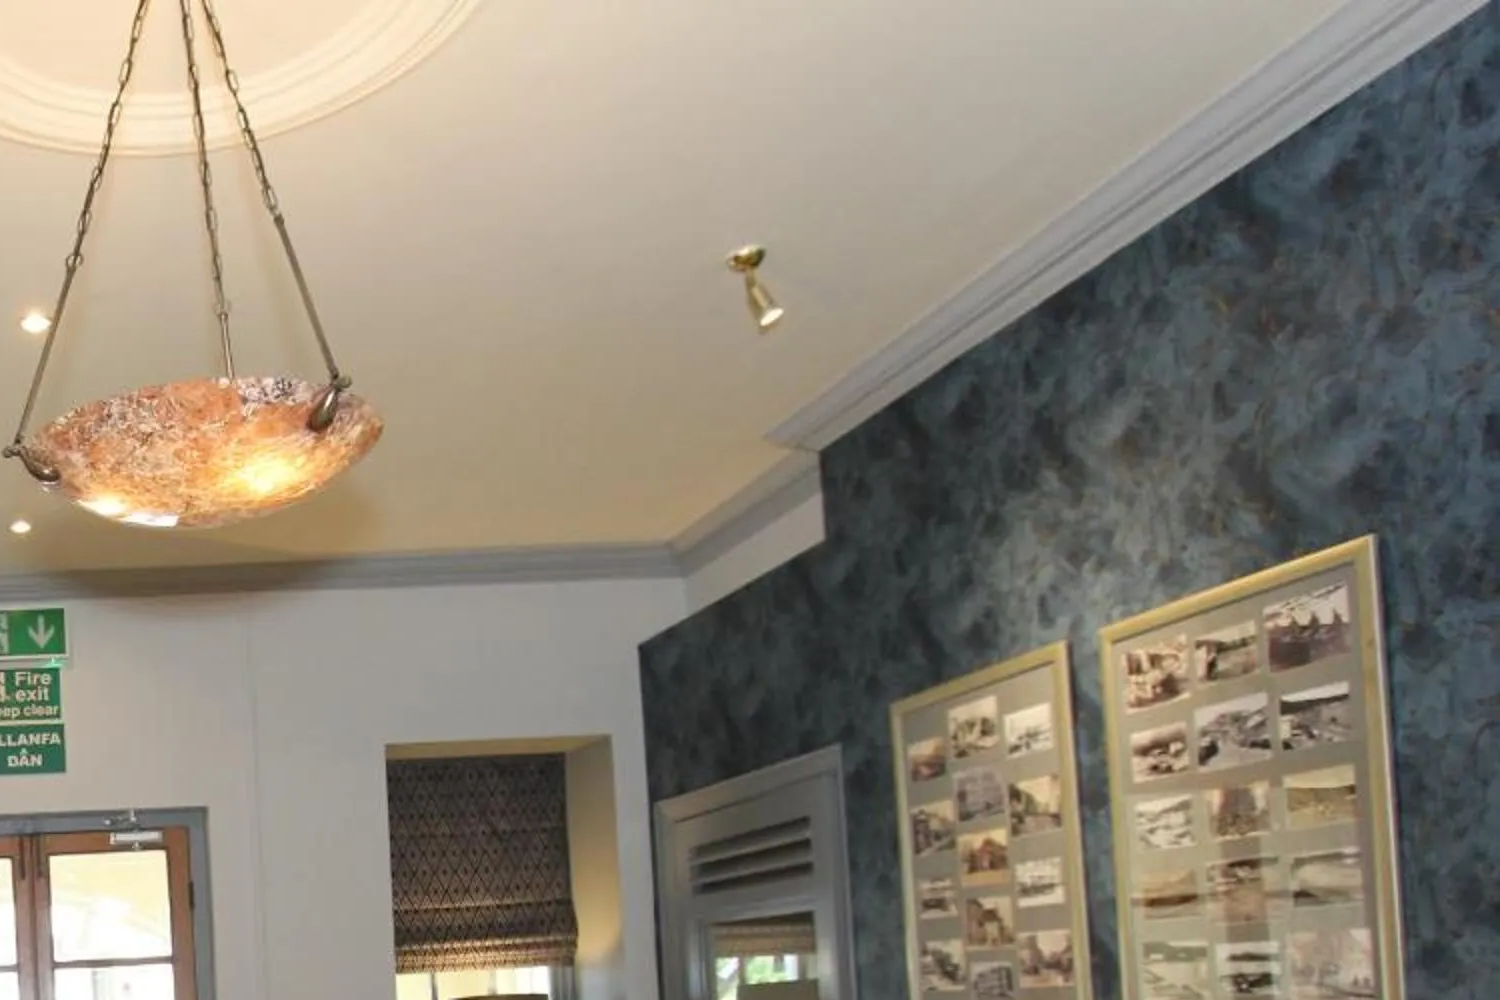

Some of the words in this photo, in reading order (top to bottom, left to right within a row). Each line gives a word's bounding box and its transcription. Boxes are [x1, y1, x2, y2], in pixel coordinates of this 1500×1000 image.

[14, 671, 52, 686] Fire
[15, 687, 49, 702] exit
[23, 704, 58, 716] clear
[7, 747, 43, 767] DÂN
